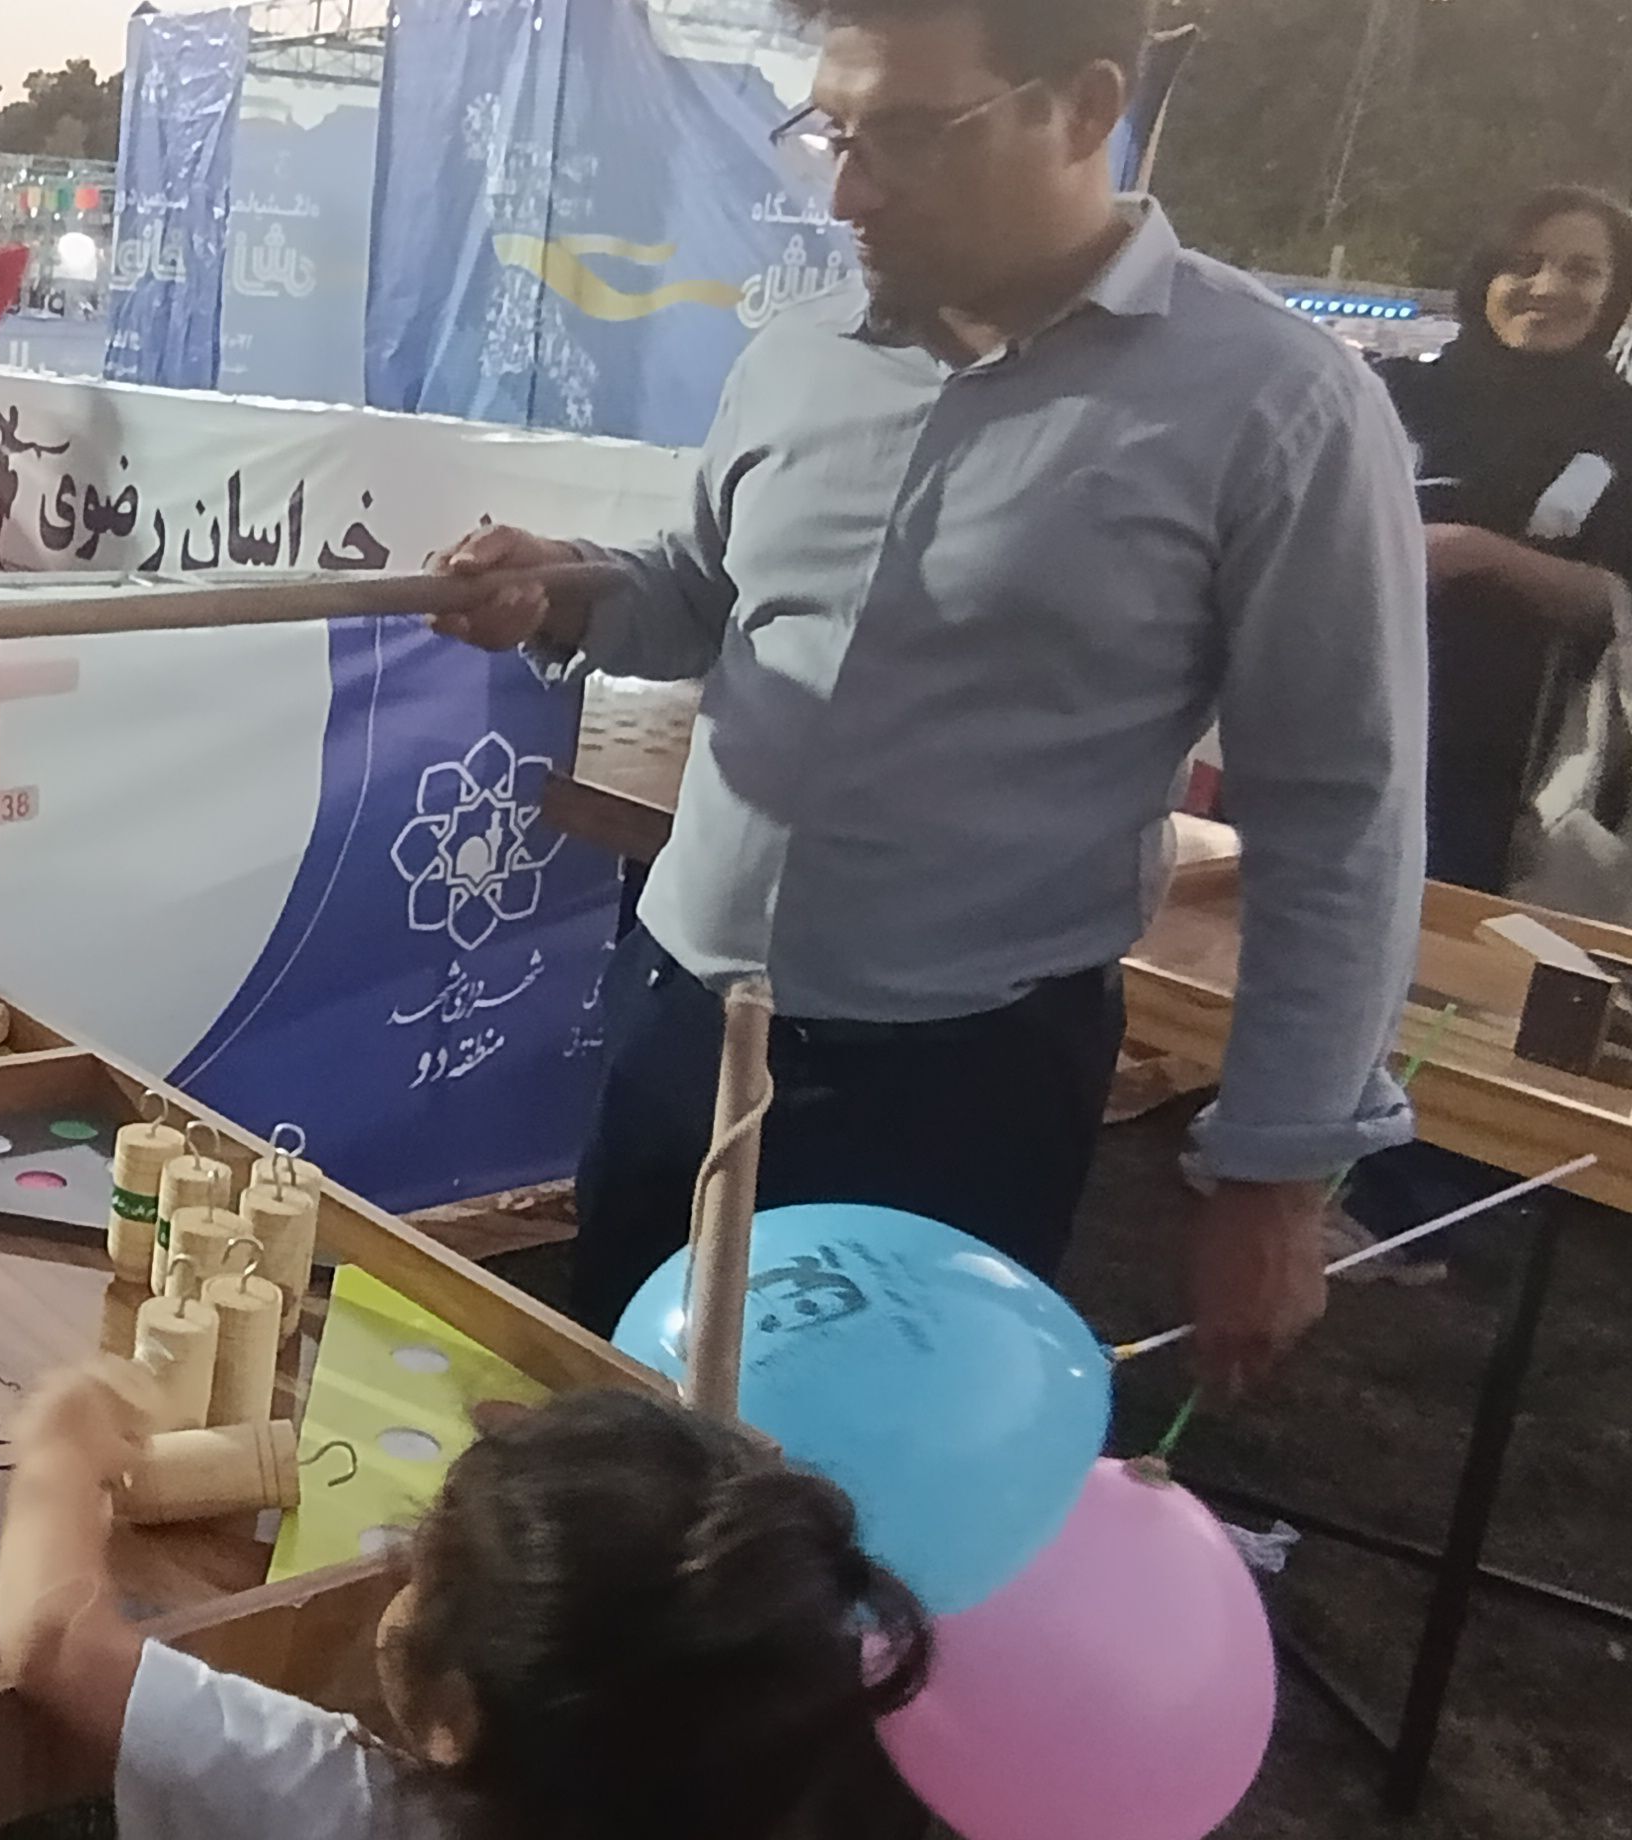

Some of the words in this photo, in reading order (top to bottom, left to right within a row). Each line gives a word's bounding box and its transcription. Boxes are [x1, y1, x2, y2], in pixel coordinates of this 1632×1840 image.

[39, 454, 167, 573] رضوی
[1, 793, 31, 822] 38
[409, 1046, 449, 1090] دو
[446, 1027, 505, 1079] منطقه
